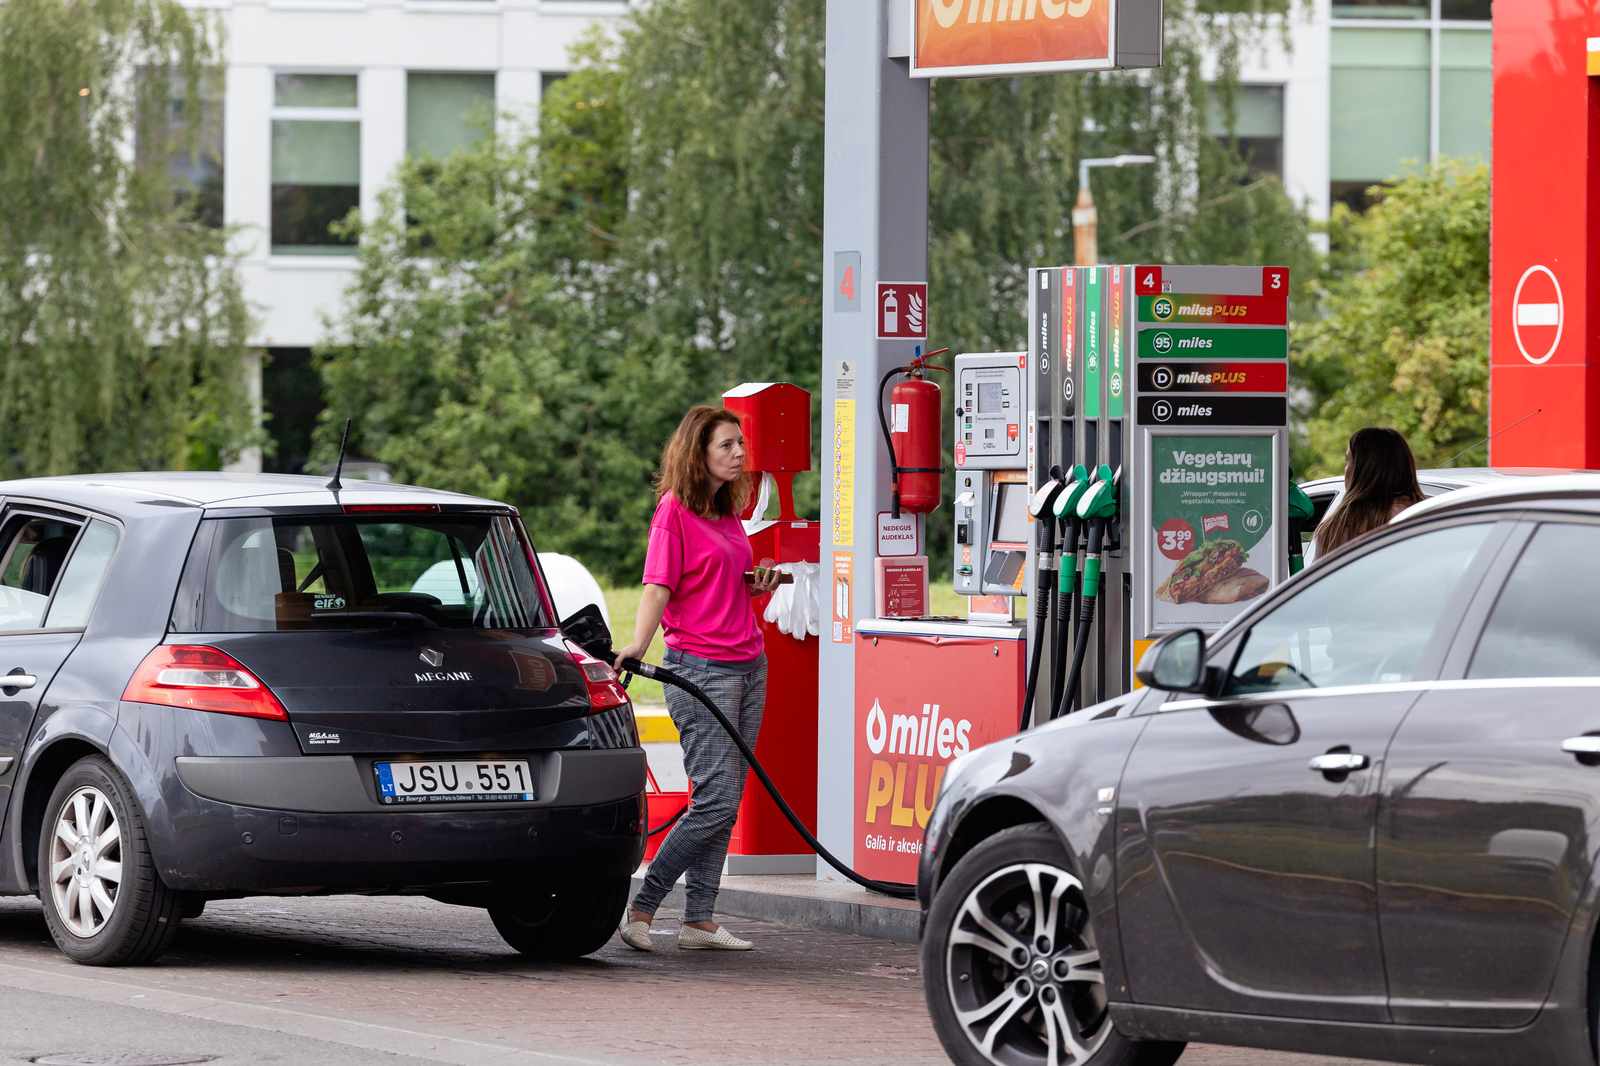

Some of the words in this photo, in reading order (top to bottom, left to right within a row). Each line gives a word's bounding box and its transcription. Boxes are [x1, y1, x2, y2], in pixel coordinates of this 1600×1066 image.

[839, 265, 855, 301] 4
[1143, 273, 1154, 288] 4
[1271, 274, 1281, 289] 3
[1155, 303, 1171, 314] 95
[1155, 337, 1171, 349] 95
[1177, 337, 1213, 349] miles
[1158, 372, 1168, 383] D
[1158, 405, 1168, 416] D
[1177, 405, 1213, 417] miles
[1172, 450, 1252, 468] Vegetarų
[1160, 468, 1265, 486] džiaugsmui!
[883, 524, 912, 532] NEDEGUS
[881, 533, 914, 541] AUDEKLAS
[314, 598, 335, 609] elf
[414, 671, 473, 683] MEGANE
[888, 703, 972, 759] miles
[399, 764, 459, 793] JSU
[476, 764, 526, 791] 551
[381, 783, 393, 792] LT
[865, 760, 946, 830] PLU
[865, 834, 887, 850] Galia
[888, 837, 896, 851] ir
[896, 839, 923, 854] akcele
